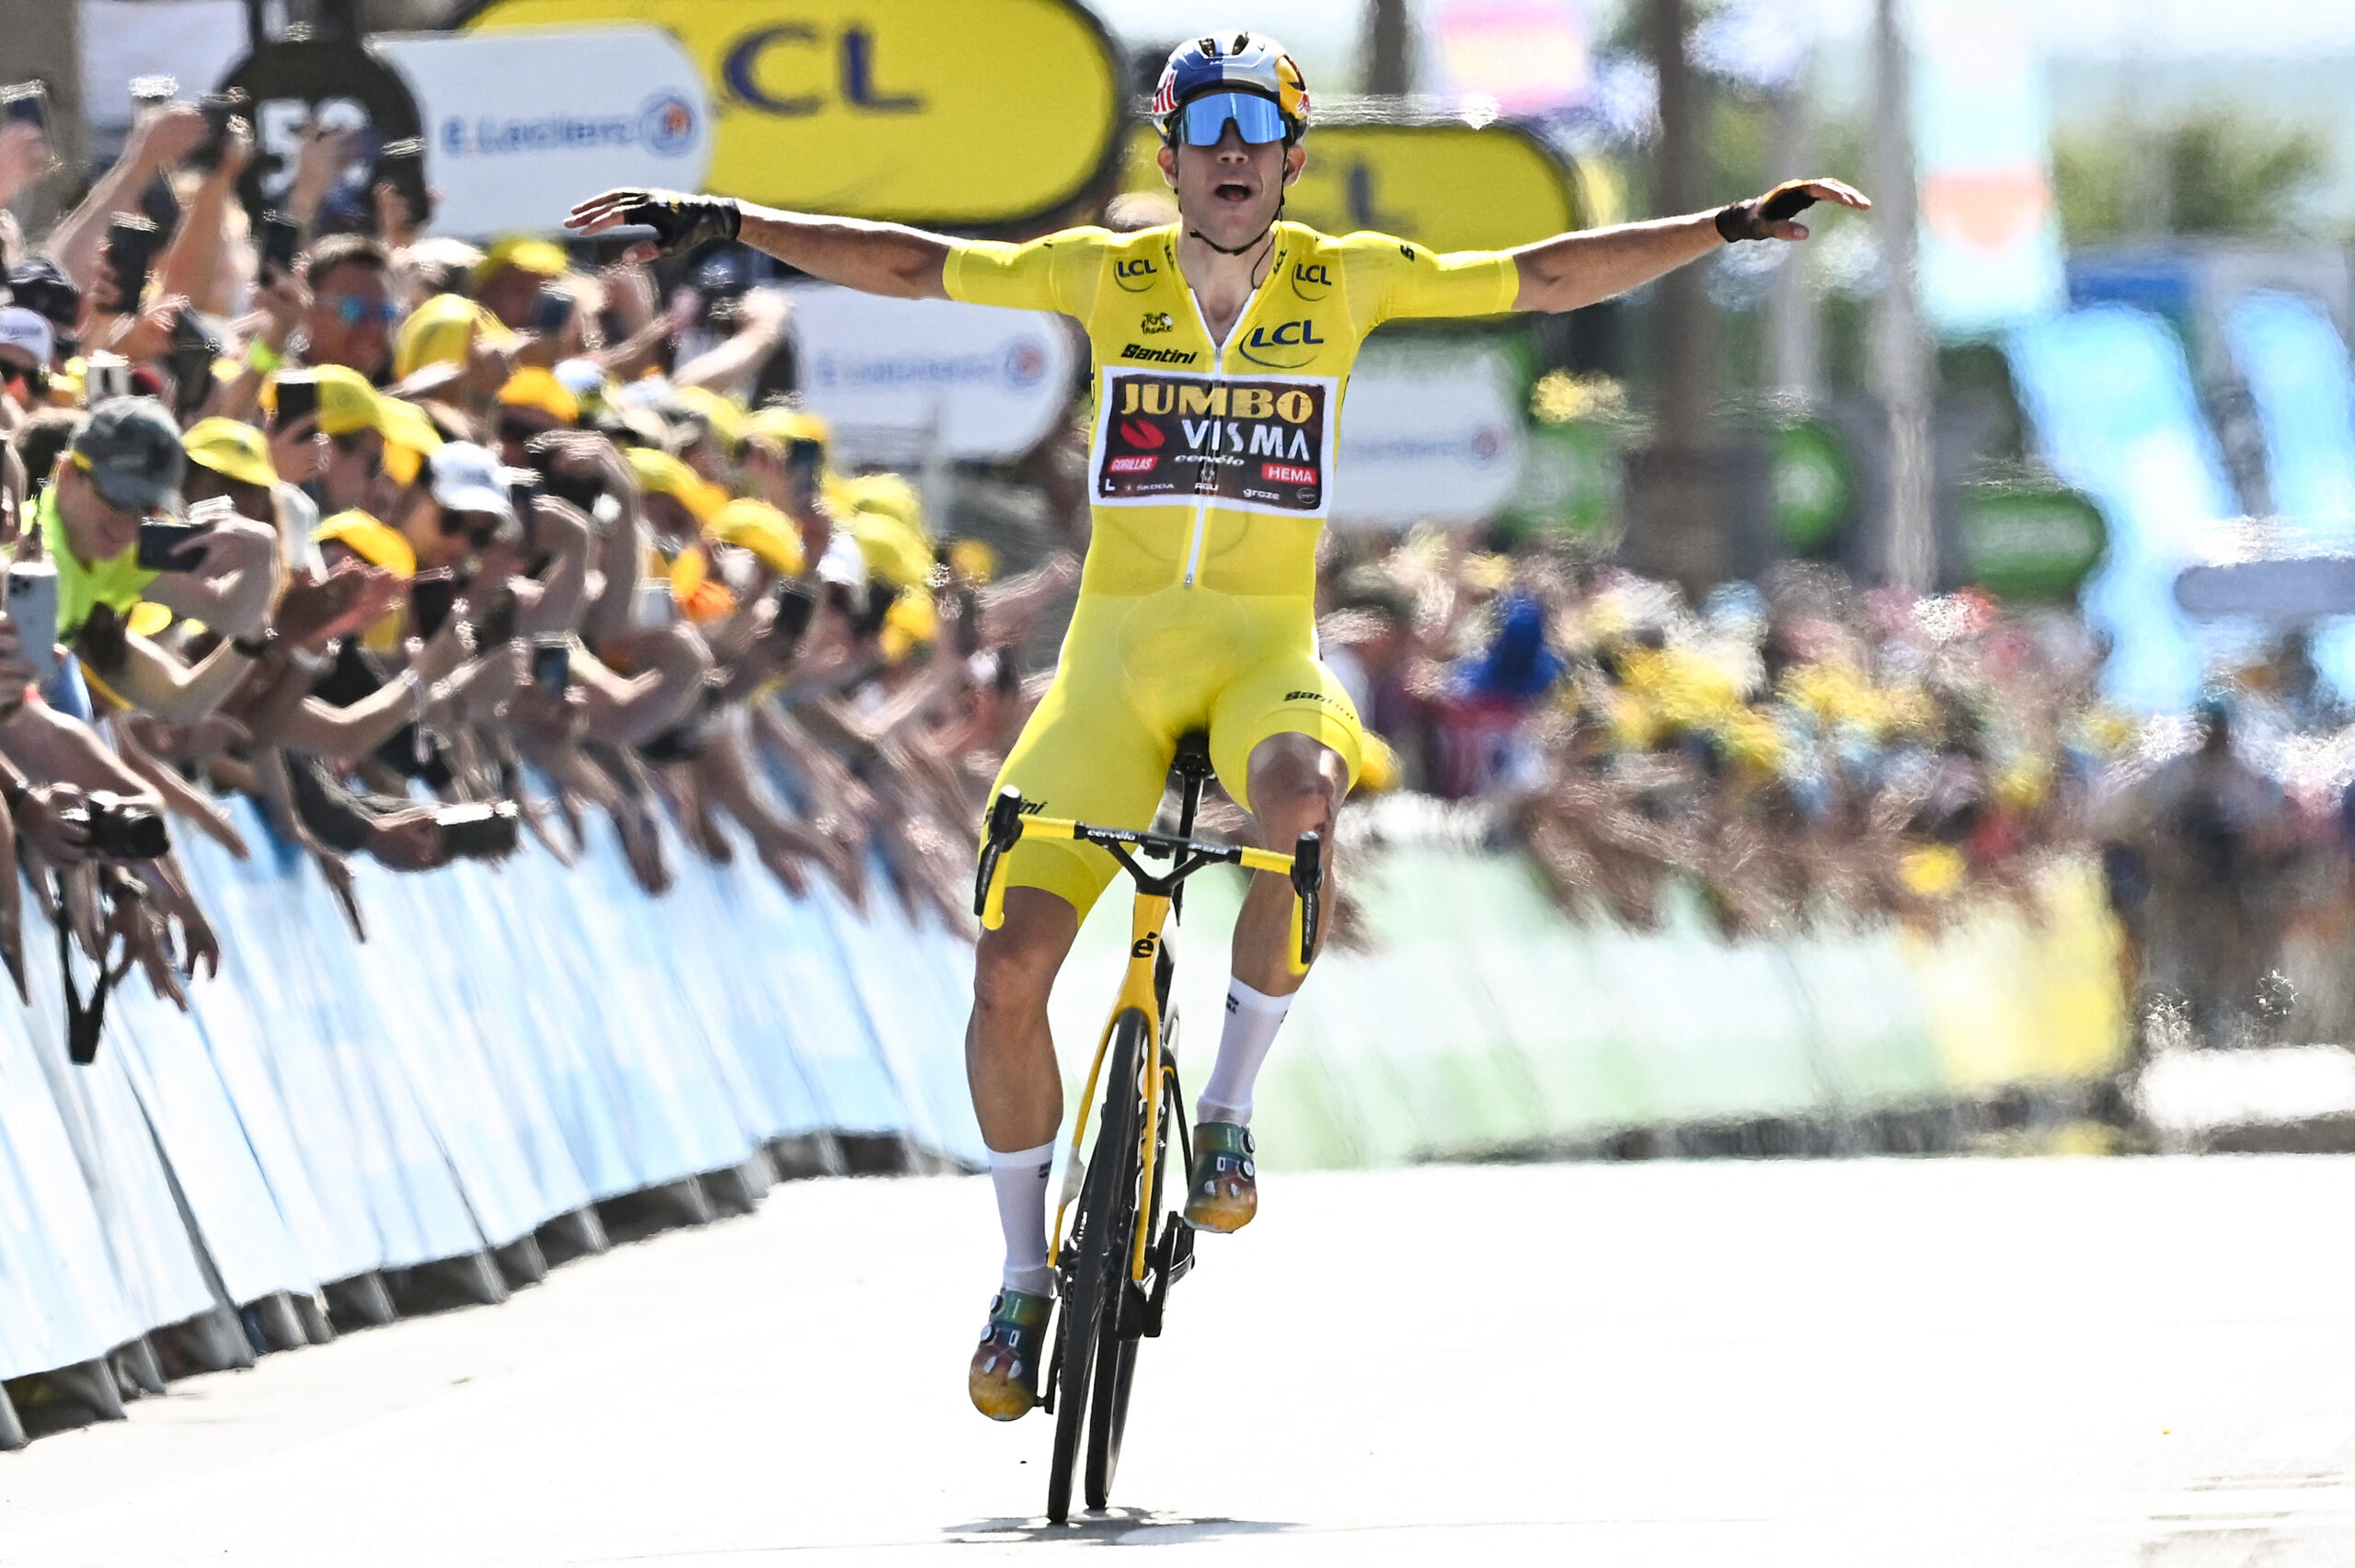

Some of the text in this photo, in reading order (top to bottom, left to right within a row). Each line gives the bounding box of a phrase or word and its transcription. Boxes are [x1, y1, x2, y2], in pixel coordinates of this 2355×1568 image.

[716, 22, 927, 117] CL
[1117, 259, 1157, 278] LCL
[1295, 263, 1332, 286] LCL
[1249, 319, 1325, 348] LCL
[1120, 344, 1199, 364] Santini
[1120, 383, 1315, 424] JUMBO
[1181, 419, 1311, 462] VISMA
[1110, 457, 1154, 472] GORILLAS
[1267, 465, 1315, 483] HEMA
